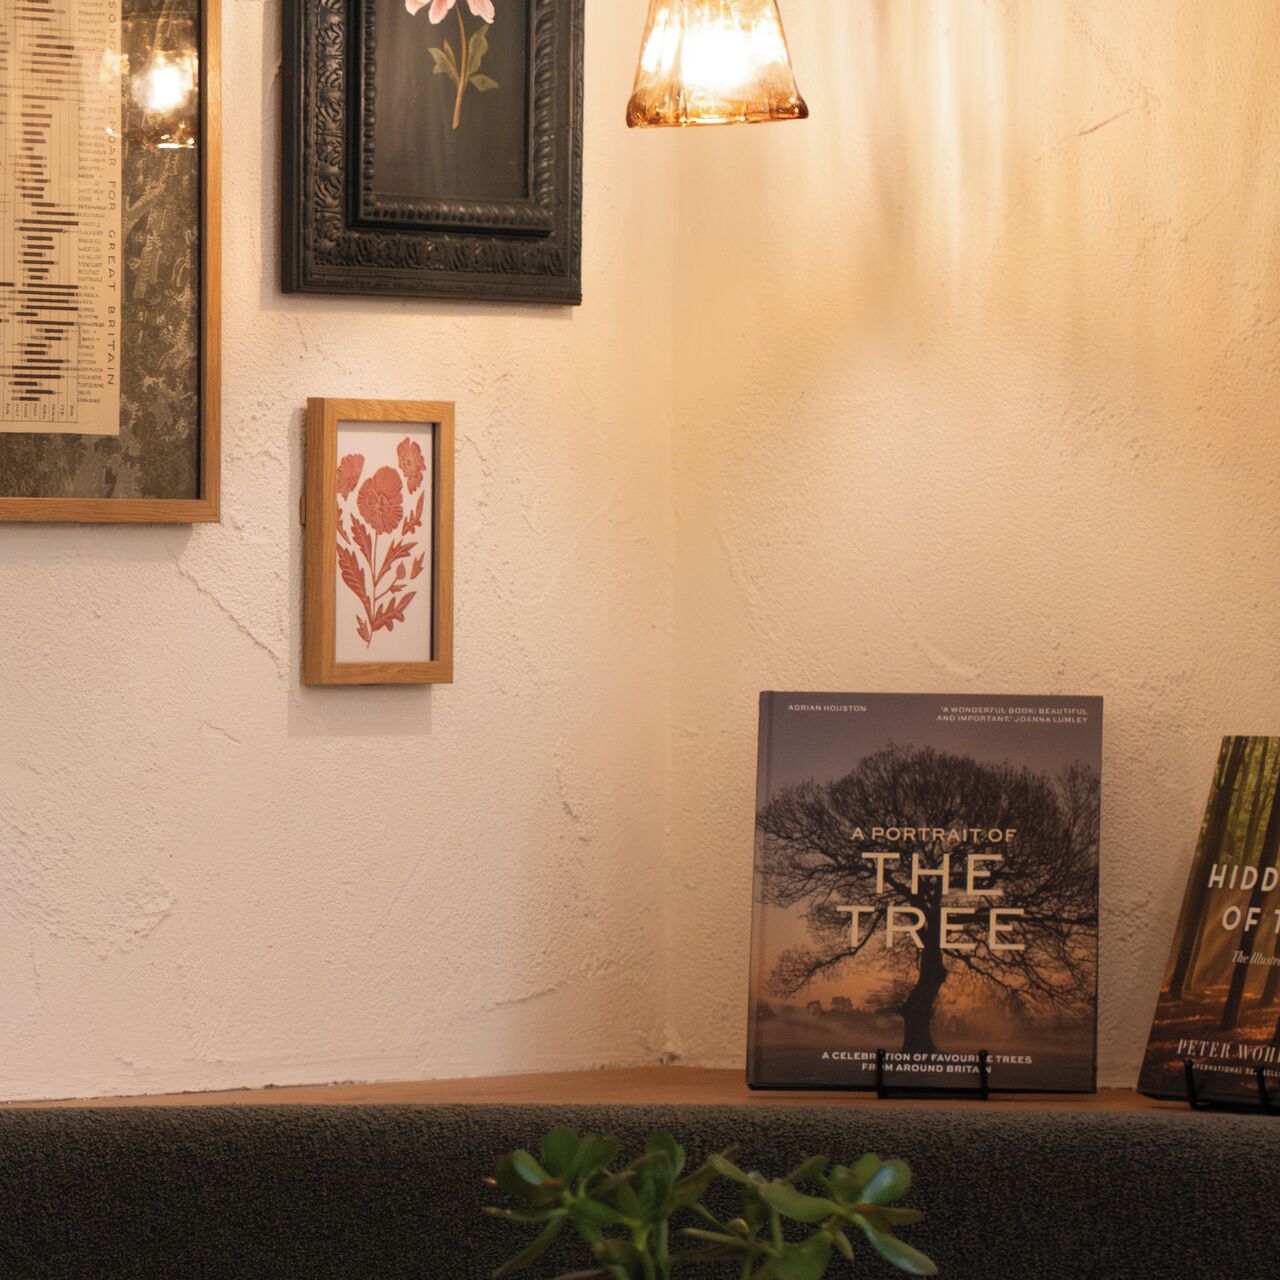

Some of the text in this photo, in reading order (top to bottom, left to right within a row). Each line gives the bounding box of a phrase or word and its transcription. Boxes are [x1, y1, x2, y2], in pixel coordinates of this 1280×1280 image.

[108, 181, 116, 210] FOR
[108, 229, 116, 292] GREAT
[107, 306, 115, 385] BRITAIN
[787, 704, 822, 712] ADRIAN
[851, 826, 1018, 843] A PORTRAIT OF
[861, 852, 1004, 896] THE
[836, 905, 1026, 951] TREE
[1222, 905, 1262, 932] OF
[822, 1052, 1032, 1064] A CELEBRTION OF FAVOURIE TREES
[1176, 1038, 1231, 1058] PETER
[861, 1062, 992, 1074] FRM AROUND BRITAN
